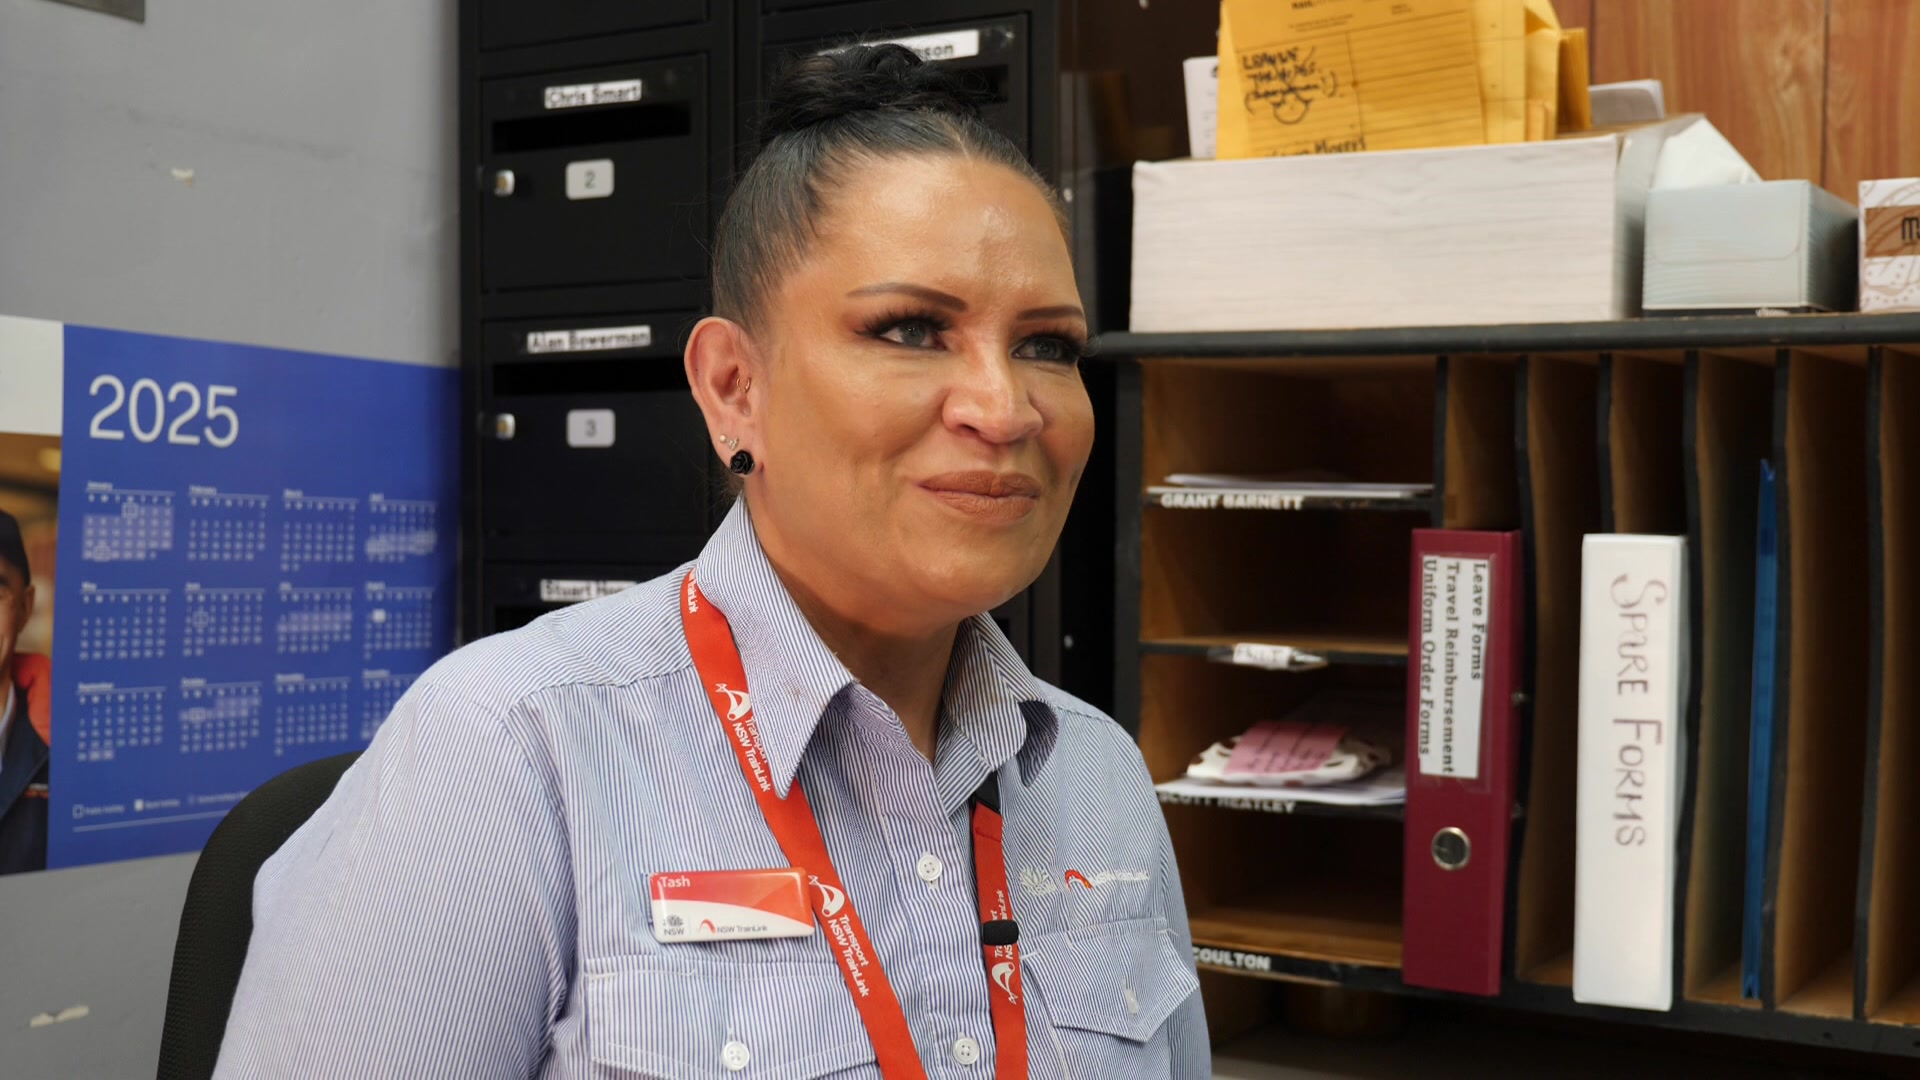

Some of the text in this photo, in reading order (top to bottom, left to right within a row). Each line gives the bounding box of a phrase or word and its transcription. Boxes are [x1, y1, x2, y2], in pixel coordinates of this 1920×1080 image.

[549, 83, 639, 107] Chris Smart
[584, 169, 596, 189] 2
[531, 328, 648, 351] Alan Bowerman
[89, 374, 239, 448] 2025
[585, 418, 598, 438] 3
[1160, 493, 1304, 510] GRANT BARNETT
[545, 580, 591, 597] Stuart
[1471, 563, 1487, 681] Leave Forms
[1420, 559, 1438, 755] Uniform Order Forms
[1442, 562, 1460, 773] Travel Reimbursement
[732, 722, 771, 793] NSW TrainLink
[1612, 718, 1662, 847] FORMS
[660, 875, 690, 888] Tash
[664, 928, 684, 936] NSW
[717, 925, 768, 934] NSW TrainLink
[839, 913, 869, 967] Transport
[827, 918, 869, 997] NSW TrainLink
